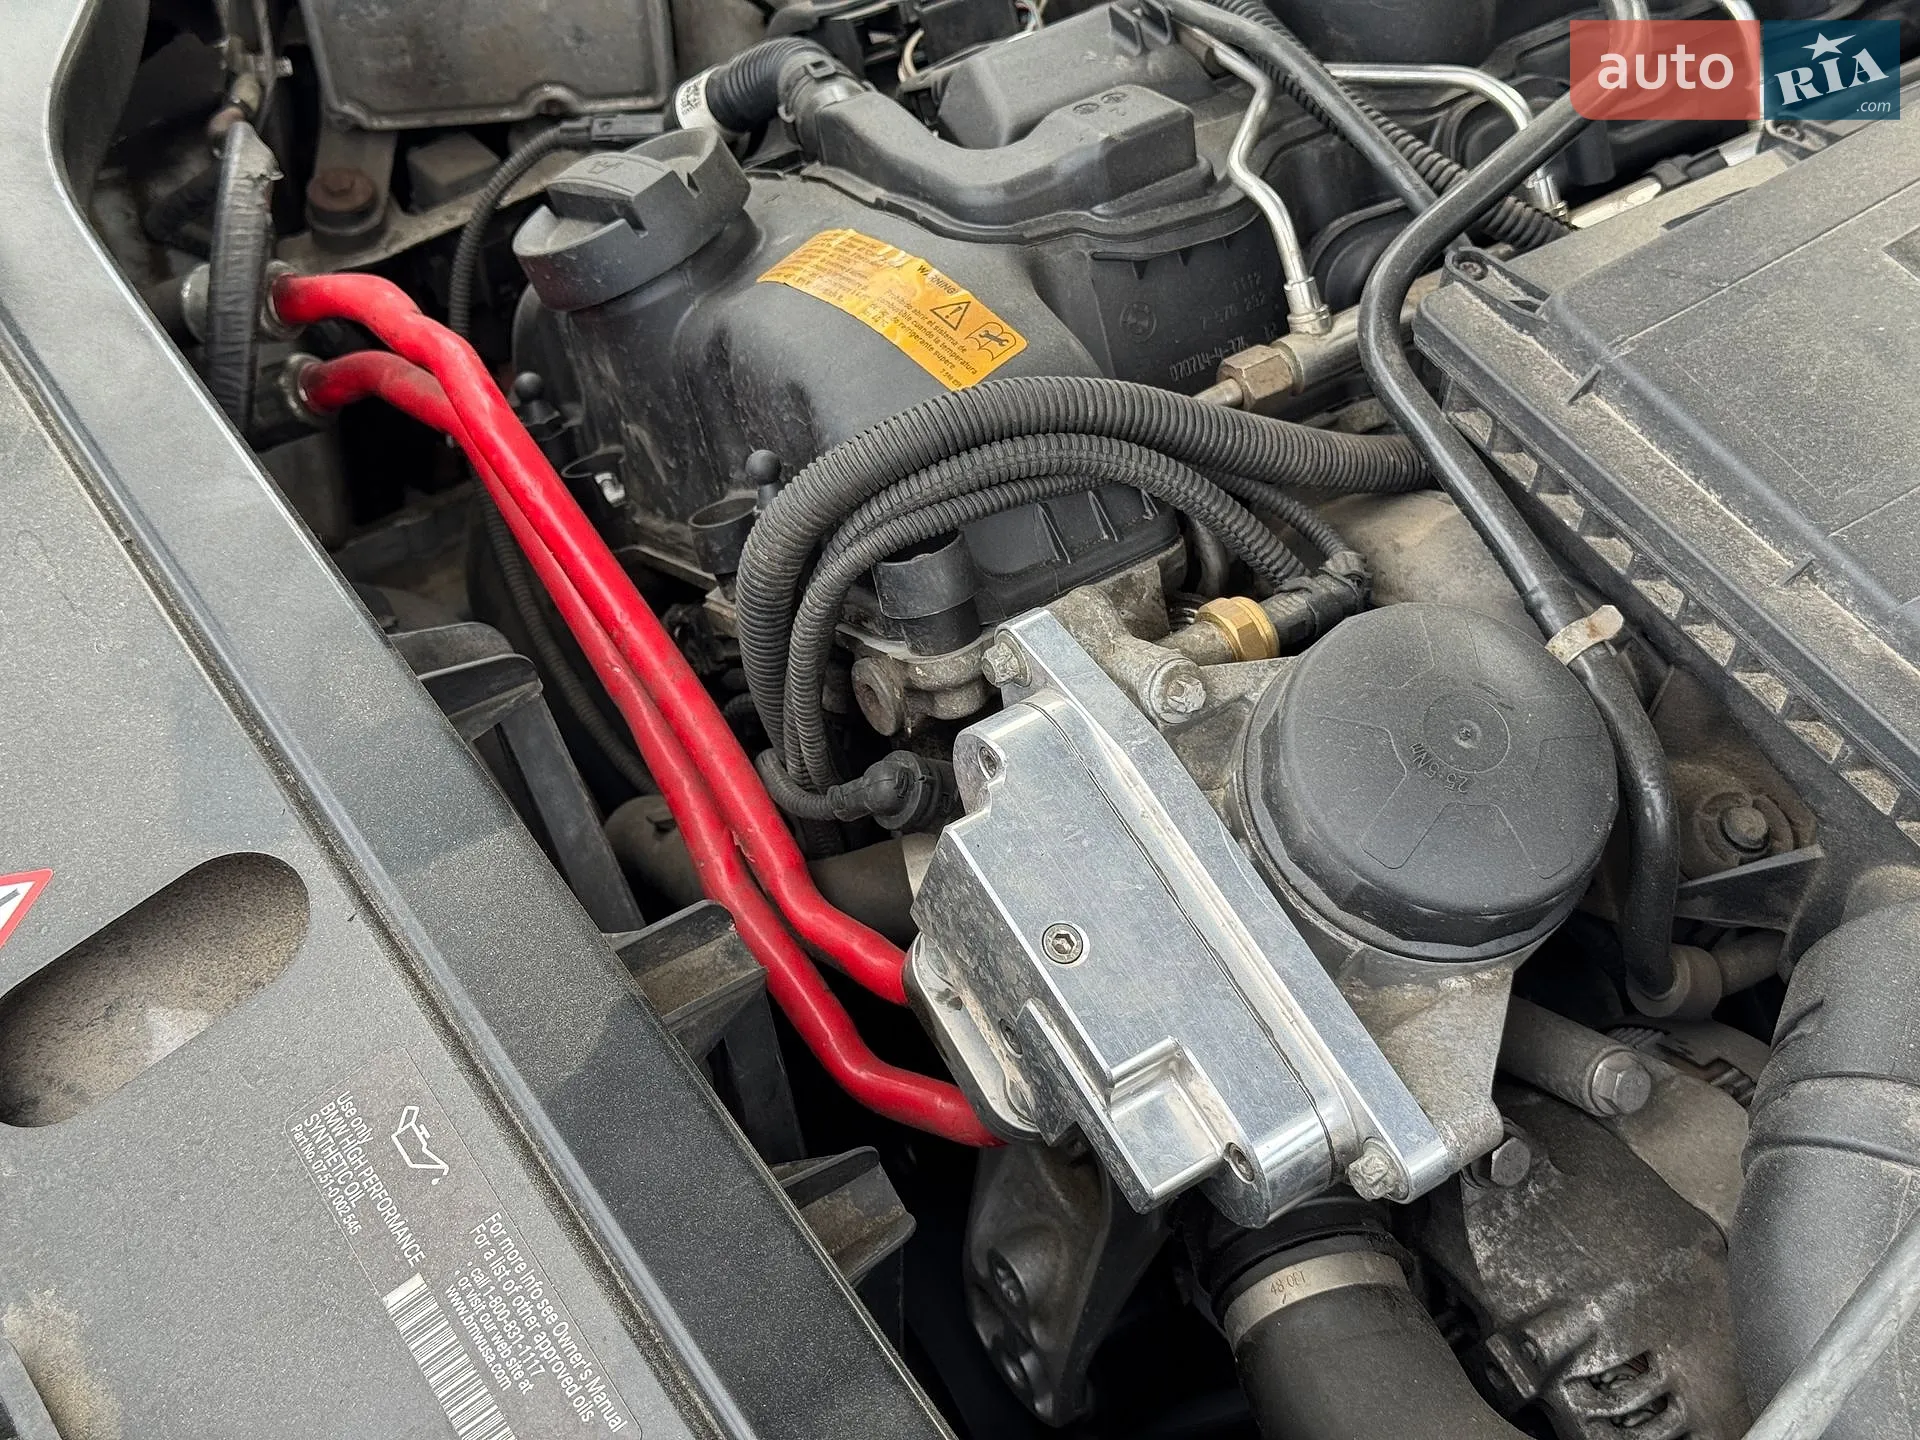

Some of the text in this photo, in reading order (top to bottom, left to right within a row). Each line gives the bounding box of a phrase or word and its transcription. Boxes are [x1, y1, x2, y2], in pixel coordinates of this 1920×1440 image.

[895, 320, 937, 353] refrigerante
[930, 349, 959, 370] supere
[909, 318, 936, 339] cuando
[910, 307, 929, 322] abrir
[925, 318, 936, 328] el
[931, 324, 961, 347] sistema
[956, 343, 969, 354] de
[931, 335, 943, 345] la
[936, 341, 981, 375] temperatura
[289, 1123, 310, 1147] Part
[334, 1089, 376, 1146] Use only
[300, 1142, 320, 1164] No.
[301, 1112, 368, 1209] SYNTHETIC OIL
[318, 1100, 426, 1268] BMW HIGH PERFORMANCE
[331, 1194, 352, 1218] 002
[341, 1212, 363, 1236] 545
[443, 1282, 513, 1392] www.bmwusa.com
[456, 1274, 536, 1396] or visit our web site at
[468, 1222, 598, 1424] For a list of other approved oils
[469, 1264, 546, 1379] call 1-800-831-1117
[483, 1211, 510, 1240] For
[497, 1235, 528, 1275] more
[535, 1296, 560, 1326] see
[549, 1319, 597, 1382] Owner's
[583, 1374, 628, 1434] Manual
